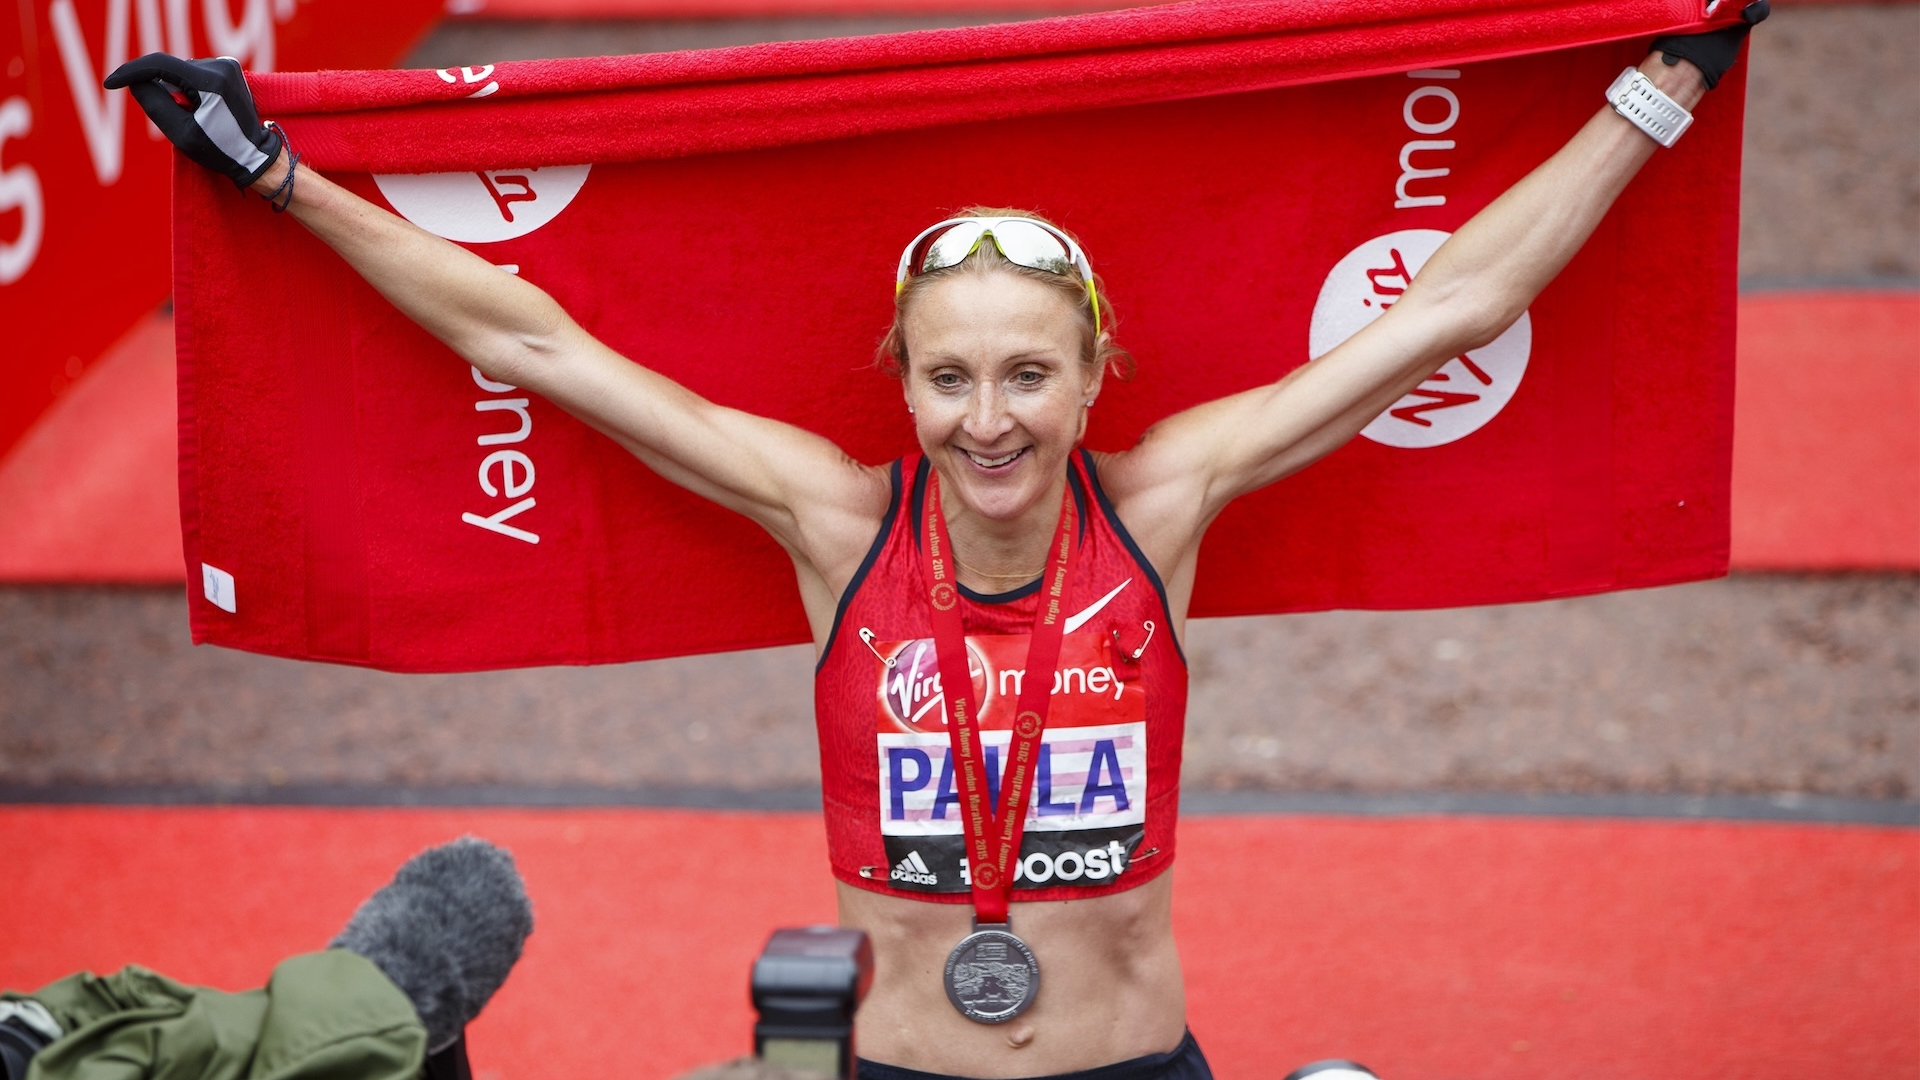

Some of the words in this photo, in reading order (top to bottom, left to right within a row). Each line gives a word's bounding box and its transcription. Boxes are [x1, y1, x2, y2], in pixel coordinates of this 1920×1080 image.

[928, 514, 940, 557] Marathon
[1056, 533, 1071, 565] London
[932, 558, 945, 580] 2015
[1050, 566, 1067, 597] Money
[1044, 598, 1061, 625] Virgin
[954, 697, 966, 726] Virgin
[959, 727, 971, 758] Money
[1017, 741, 1031, 763] 2015
[964, 760, 976, 792] London
[1008, 764, 1026, 809] Marathon
[969, 794, 983, 837] Marathon
[1001, 809, 1016, 841] London
[975, 838, 988, 860] 2015
[890, 868, 938, 886] adidas
